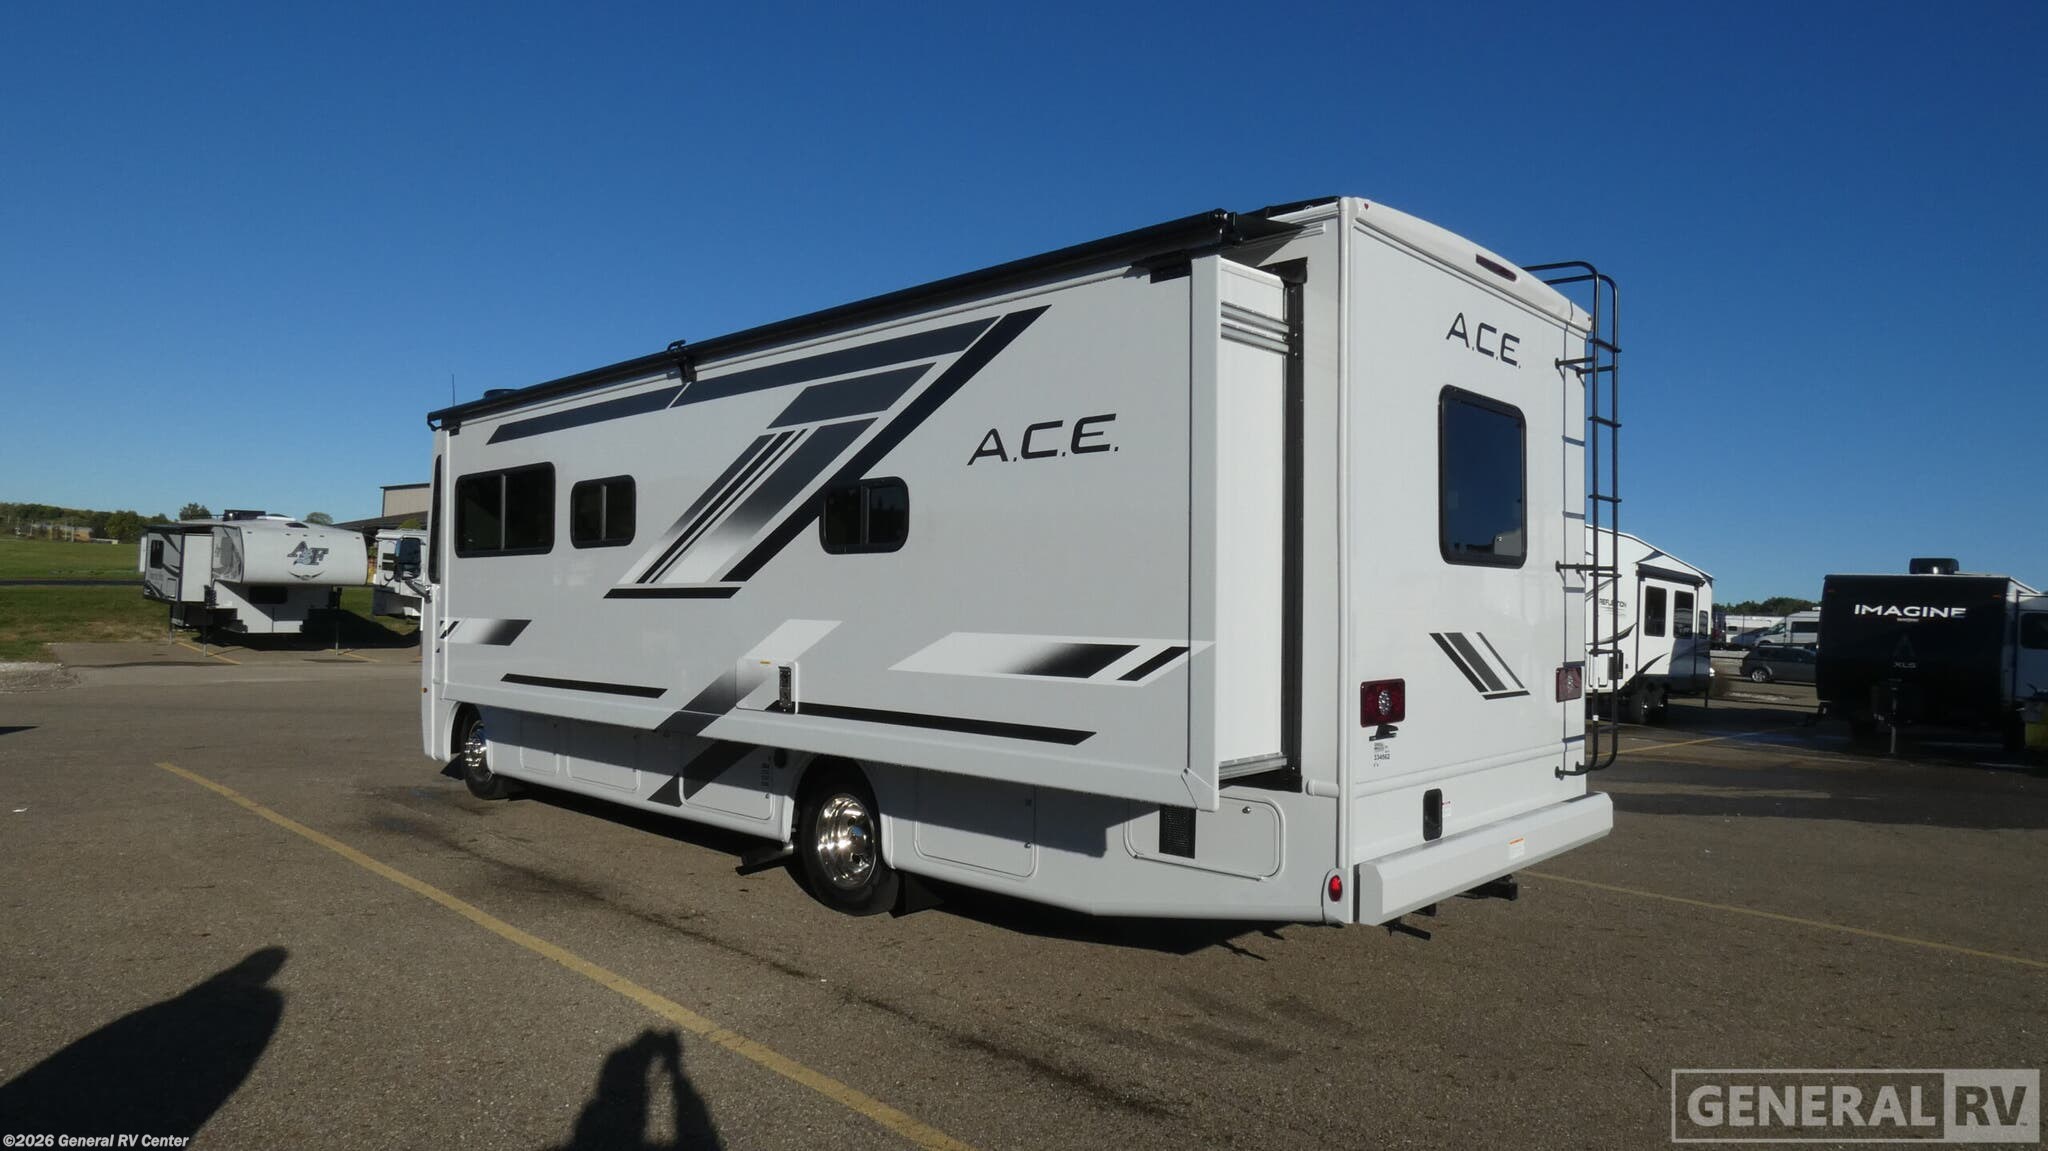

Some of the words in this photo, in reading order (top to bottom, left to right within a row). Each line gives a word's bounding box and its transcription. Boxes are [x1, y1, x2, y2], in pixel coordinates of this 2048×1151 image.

[1446, 312, 1521, 369] A.C.E.
[967, 413, 1119, 466] A.C.E.
[1854, 604, 1967, 618] IMAGINE
